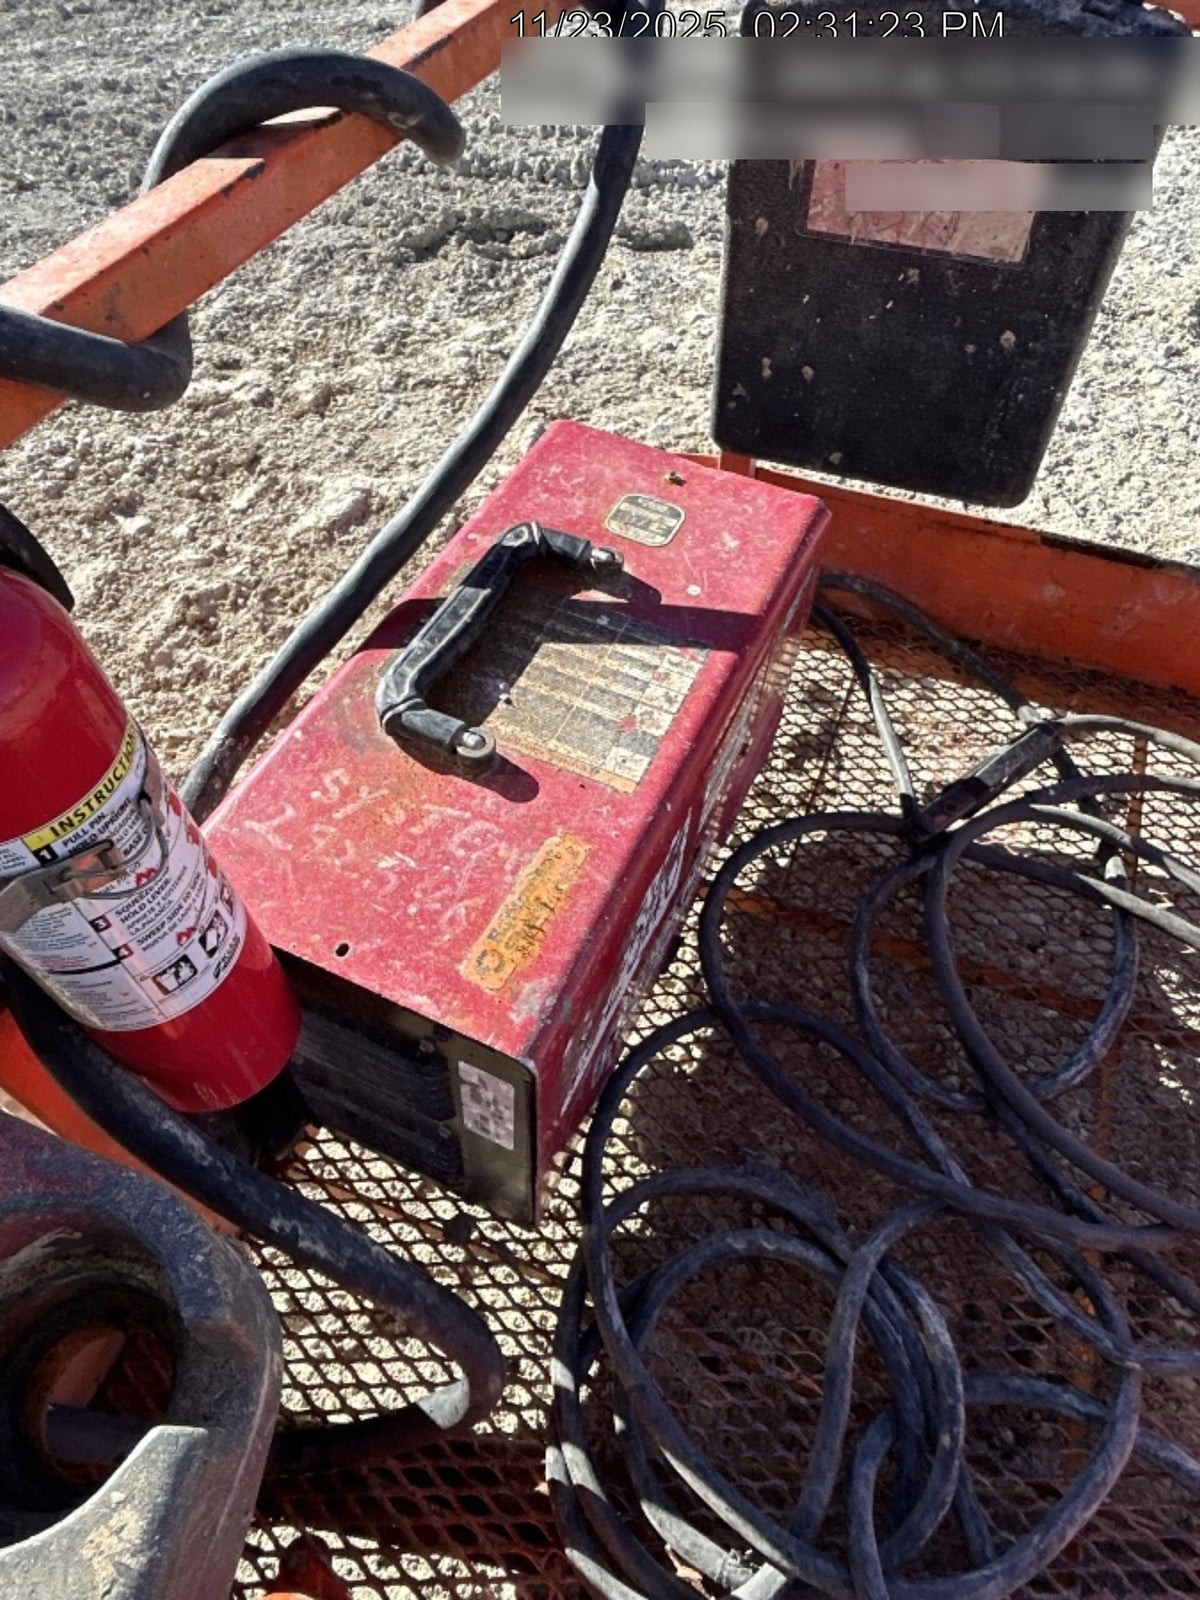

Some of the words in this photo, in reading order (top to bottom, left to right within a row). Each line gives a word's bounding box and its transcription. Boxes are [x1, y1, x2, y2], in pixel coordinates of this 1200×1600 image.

[49, 726, 136, 838] INSTRUCTION
[98, 796, 132, 835] UPRIGHT
[62, 826, 89, 848] PULL
[120, 903, 147, 924] HOLD
[136, 920, 166, 946] SWEEP
[166, 903, 184, 923] SIDE
